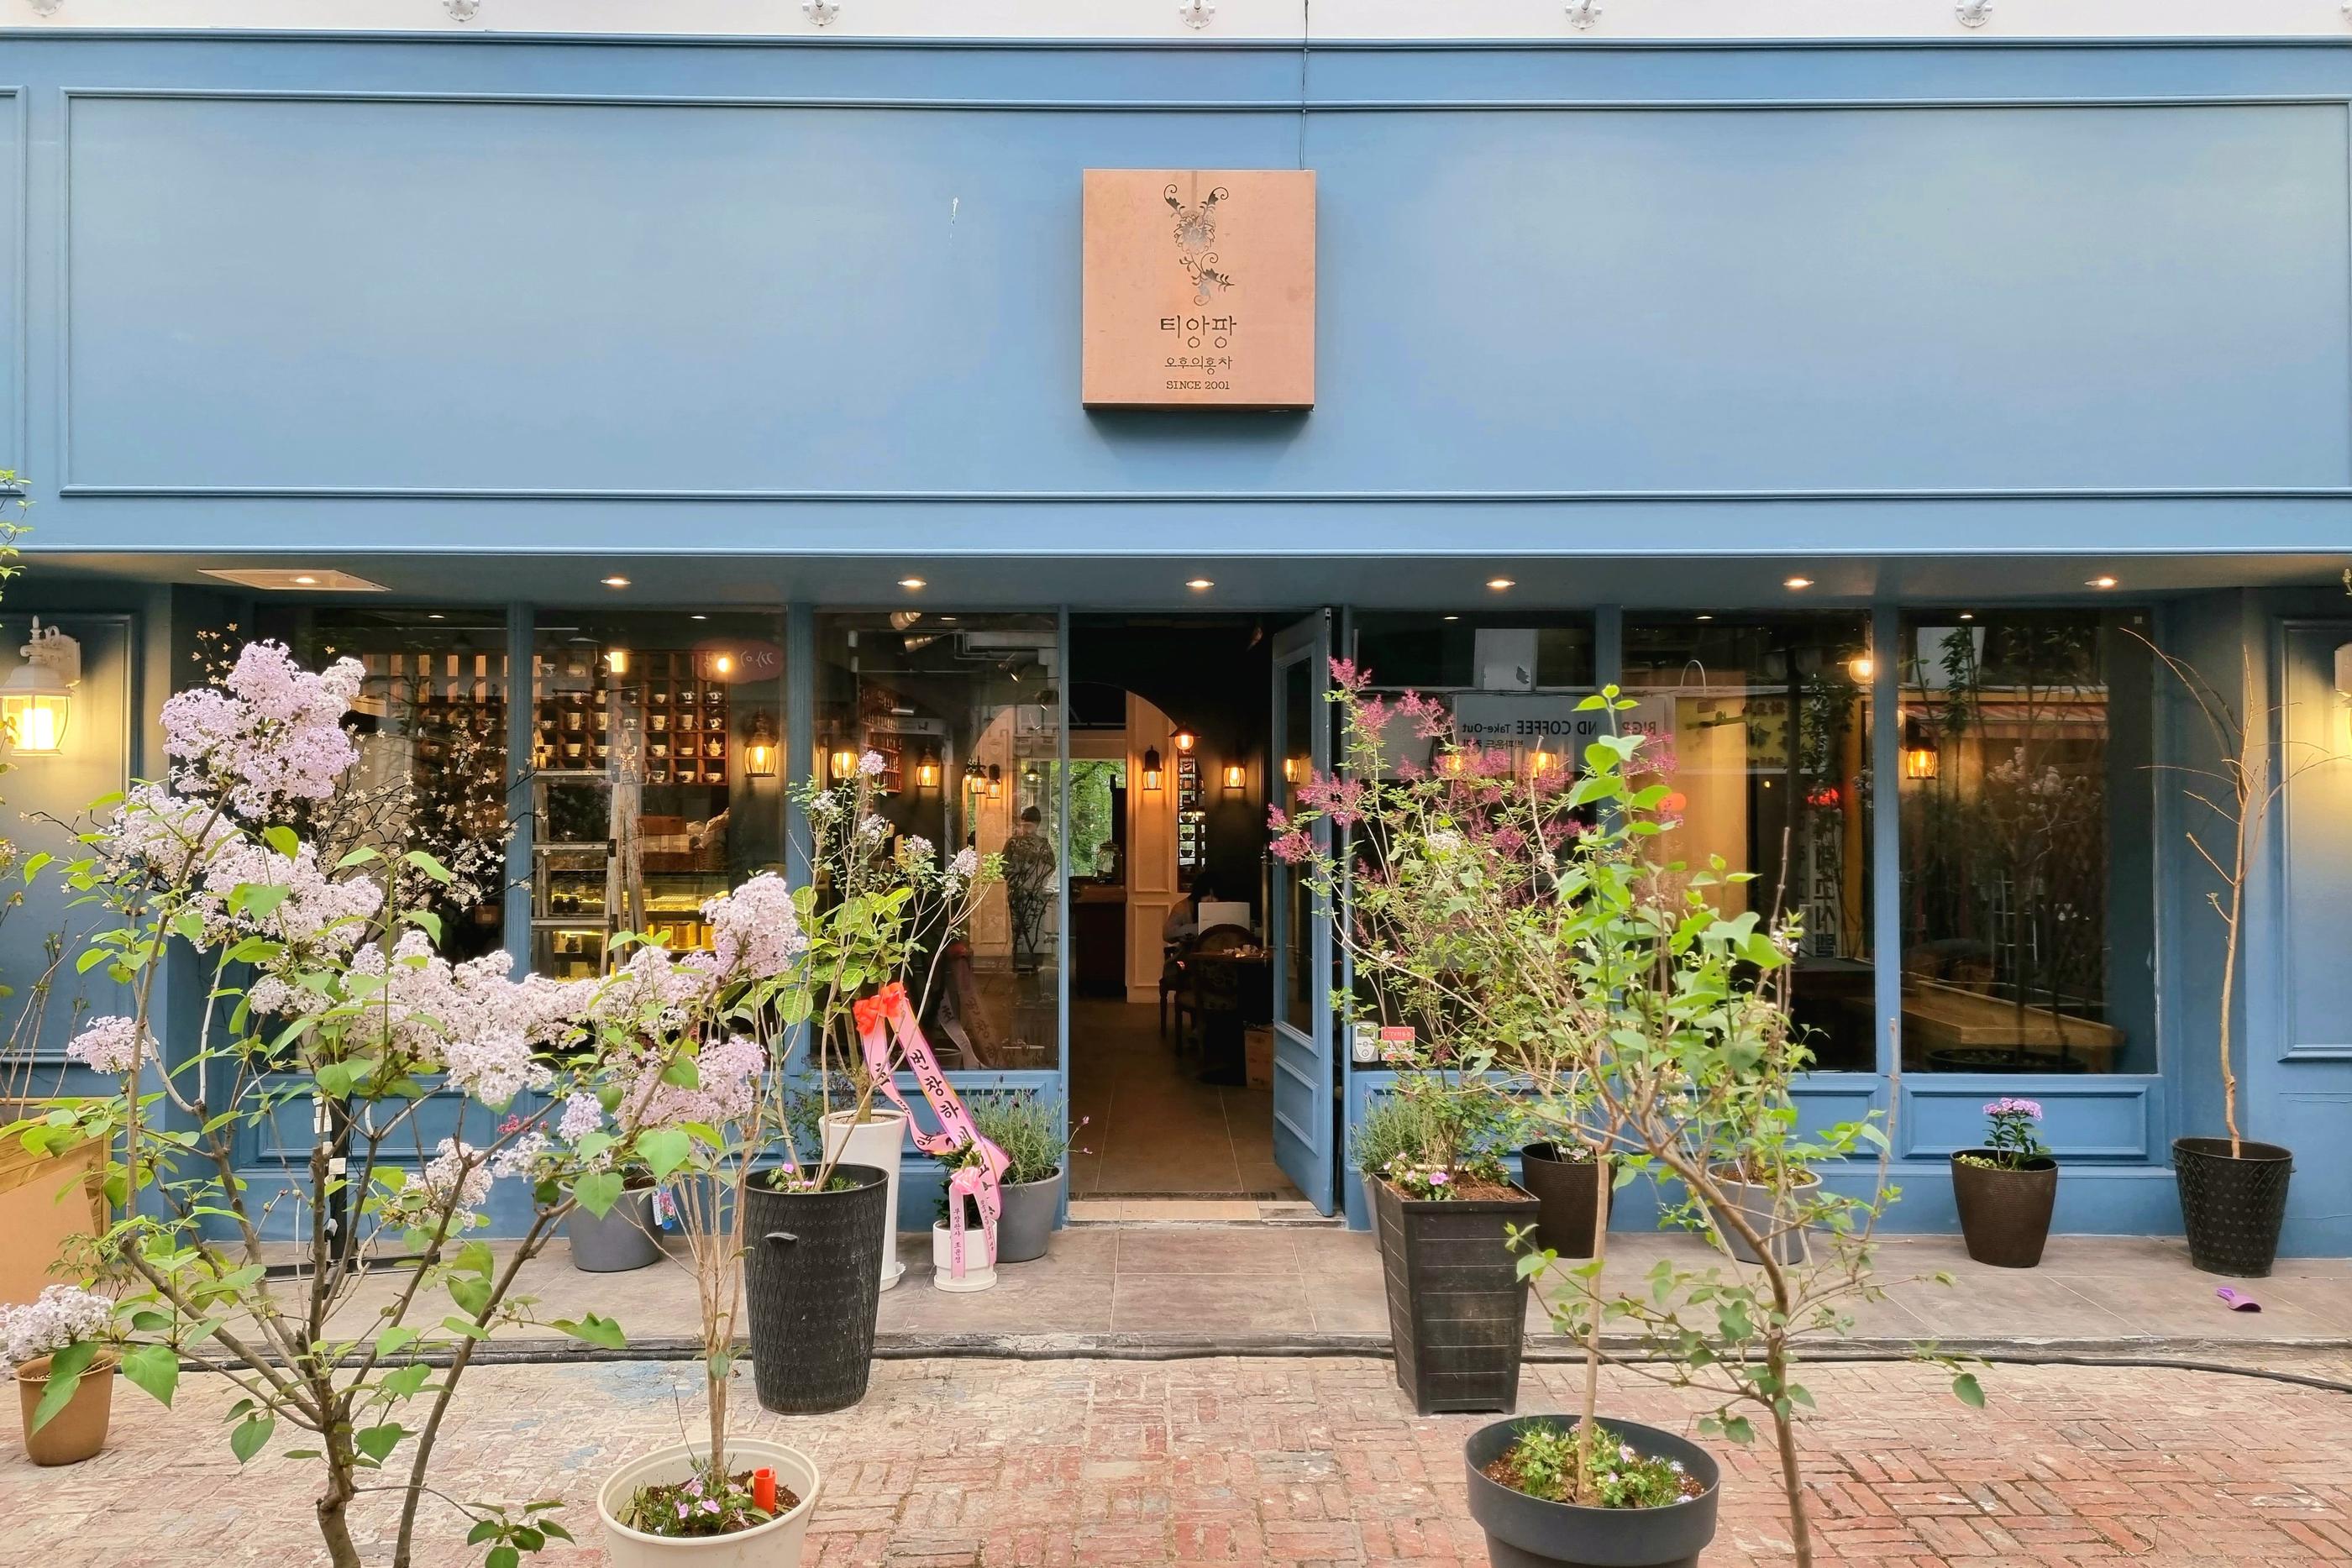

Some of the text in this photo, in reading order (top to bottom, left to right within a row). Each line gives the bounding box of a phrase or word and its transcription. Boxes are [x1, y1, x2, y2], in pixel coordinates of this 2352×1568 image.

[1160, 315, 1237, 349] 티앙팡
[1164, 355, 1233, 375] 오후의홍차
[1166, 380, 1230, 390] SINCE 2001
